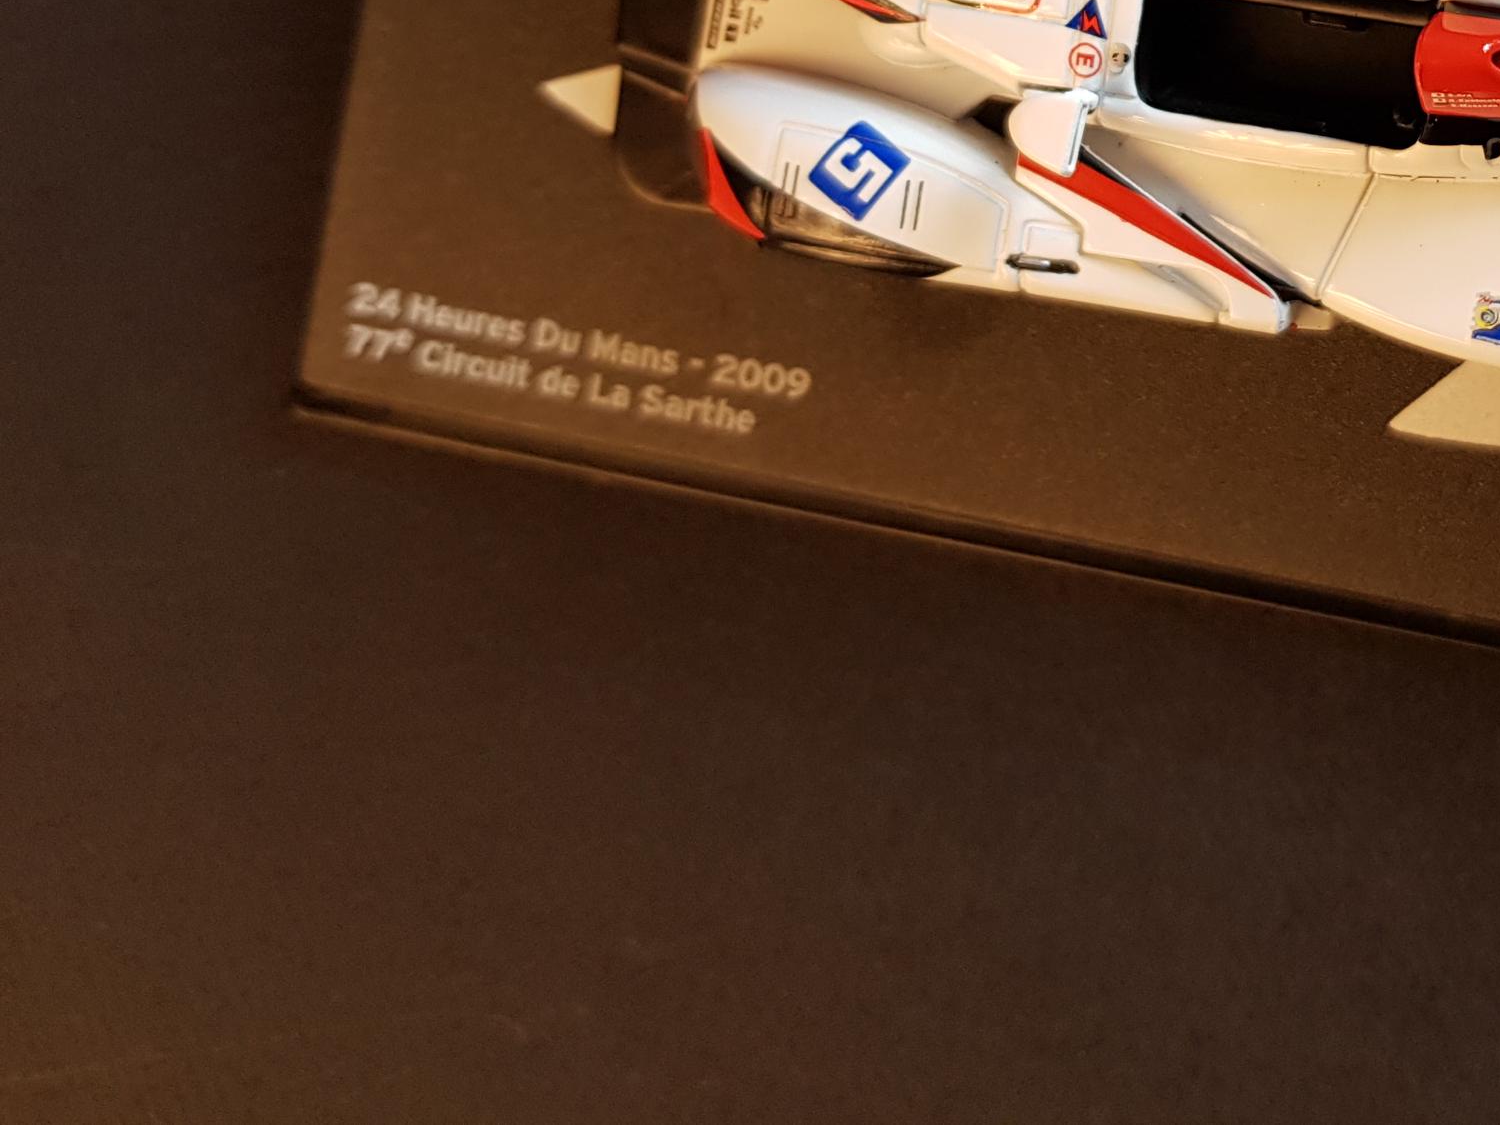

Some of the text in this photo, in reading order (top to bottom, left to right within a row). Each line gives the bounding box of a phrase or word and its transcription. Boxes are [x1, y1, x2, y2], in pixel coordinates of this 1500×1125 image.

[825, 137, 893, 203] 5
[348, 281, 401, 321] 24
[405, 291, 527, 344] Heures
[530, 317, 582, 355] Du
[586, 328, 680, 374] Mans
[710, 352, 813, 399] 2009
[416, 339, 532, 389] Circuit
[537, 365, 581, 399] de
[588, 372, 632, 410] La
[638, 383, 757, 434] Sarthe
